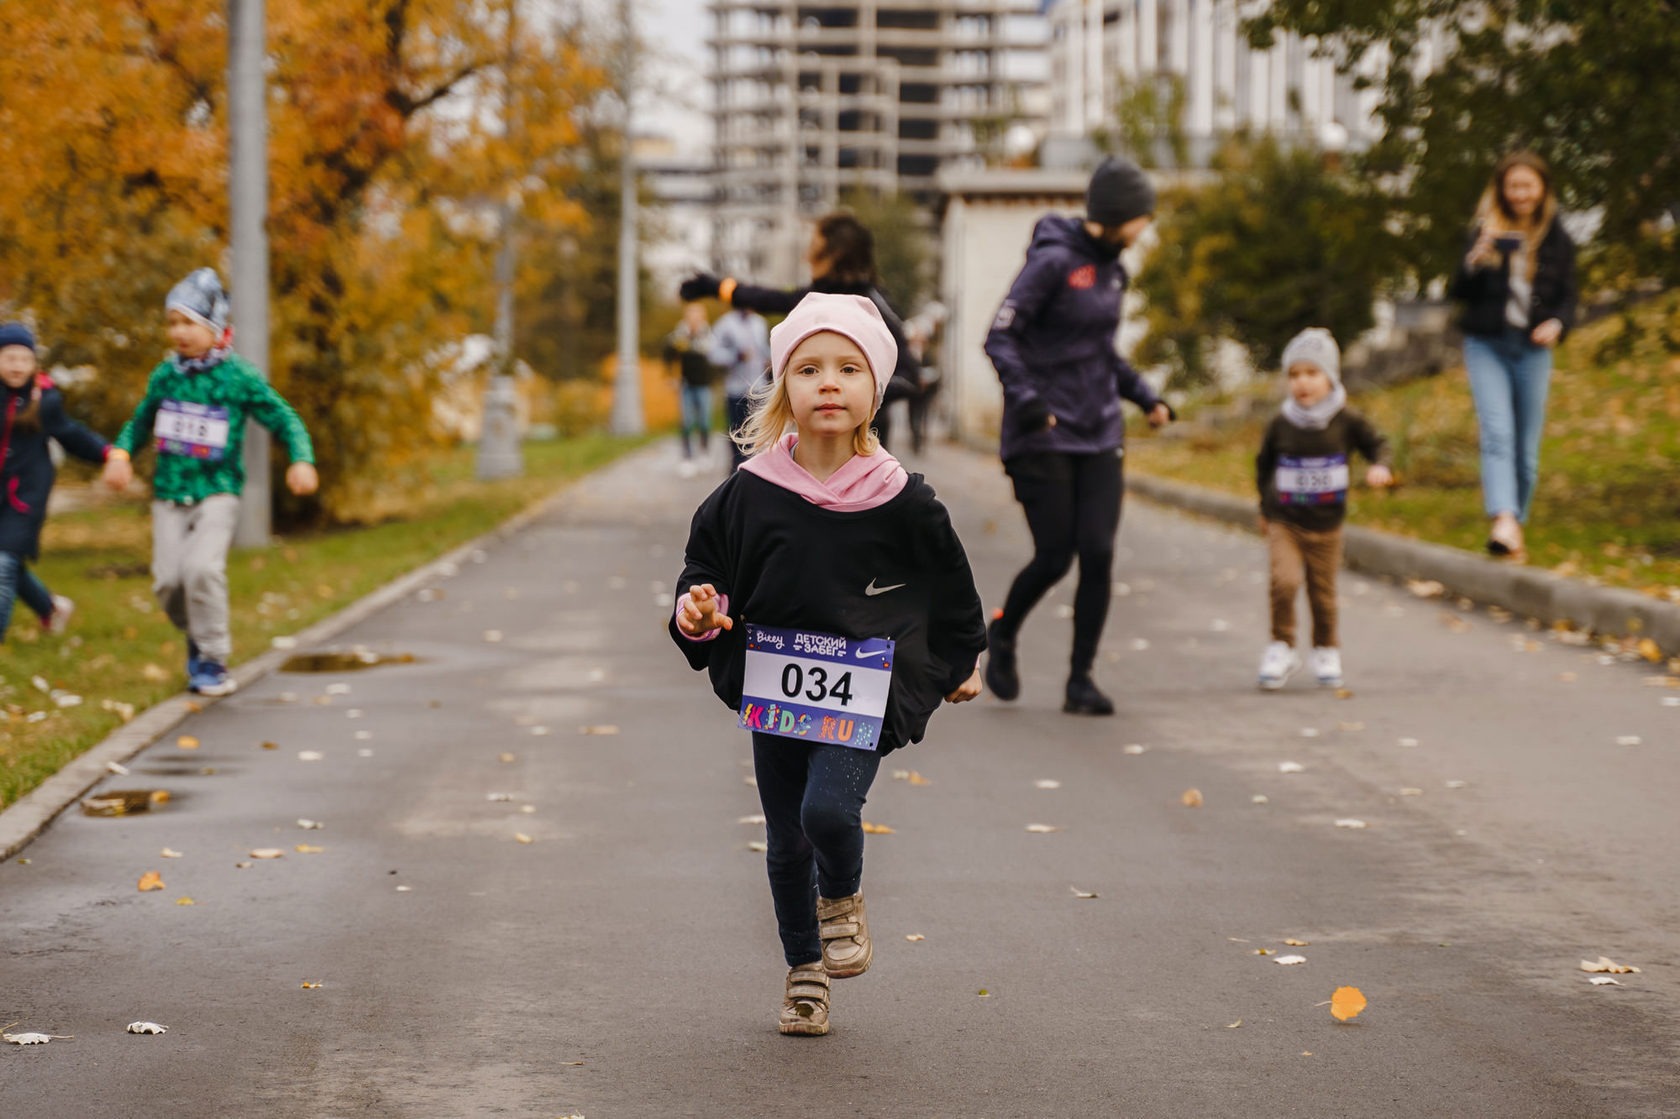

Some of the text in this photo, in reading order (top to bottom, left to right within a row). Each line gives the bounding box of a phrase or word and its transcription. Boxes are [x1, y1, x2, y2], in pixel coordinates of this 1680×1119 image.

[795, 633, 847, 650] ДЕТСКИЙ
[804, 643, 839, 657] ЗАБЕГ
[781, 663, 853, 707] 034
[744, 703, 874, 746] KIDS RUN
